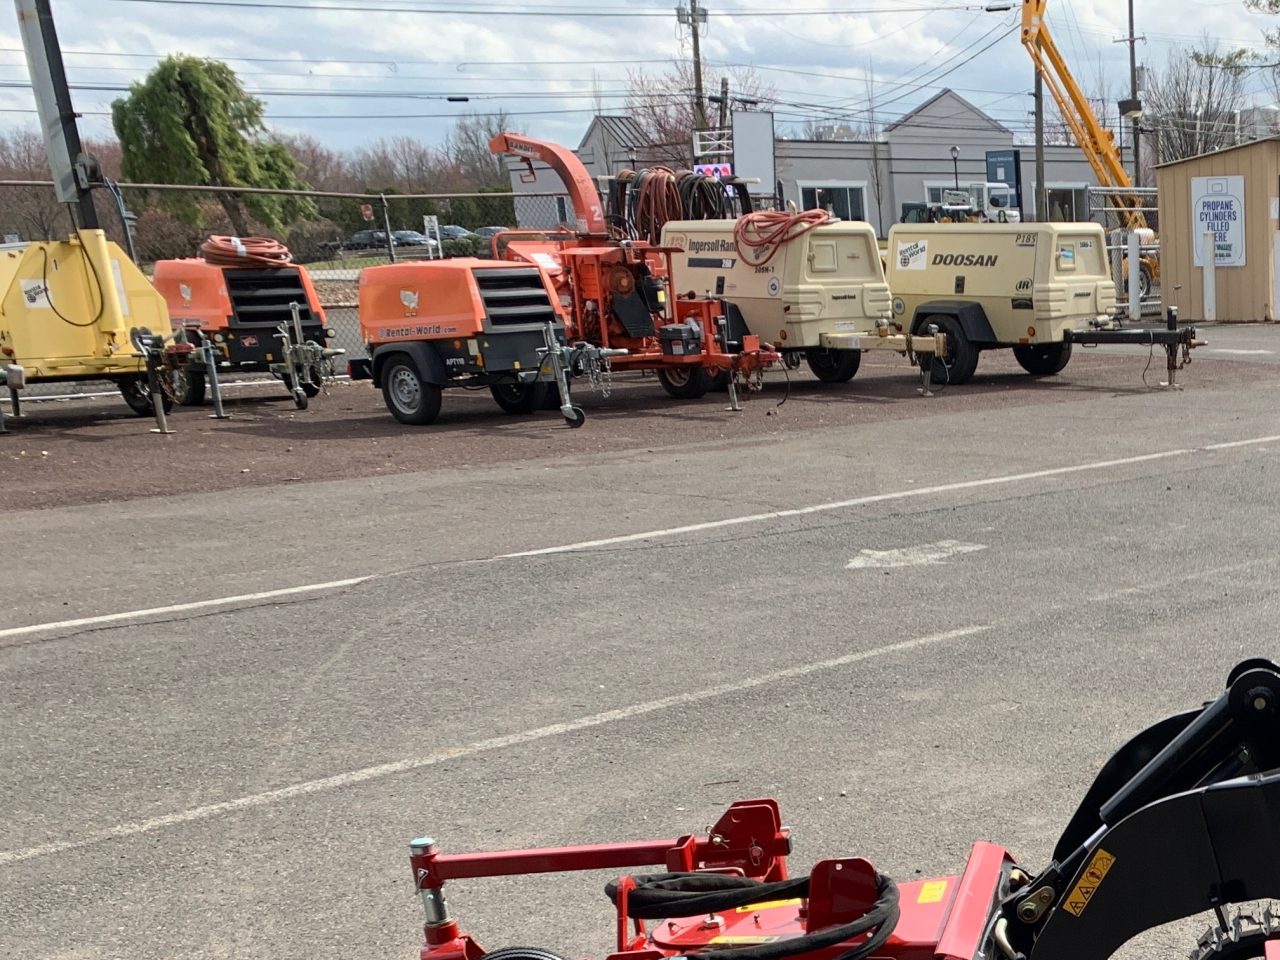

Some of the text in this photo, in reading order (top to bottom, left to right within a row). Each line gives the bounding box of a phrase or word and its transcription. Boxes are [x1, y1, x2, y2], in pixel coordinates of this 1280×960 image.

[1202, 200, 1234, 211] PROPANE
[590, 206, 603, 221] 2
[1199, 211, 1237, 222] CYLINDERS
[1206, 222, 1230, 232] FILLED
[1015, 233, 1036, 244] P185
[1214, 232, 1228, 242] ERE
[720, 240, 738, 252] Ran
[931, 253, 999, 267] DOOSAN
